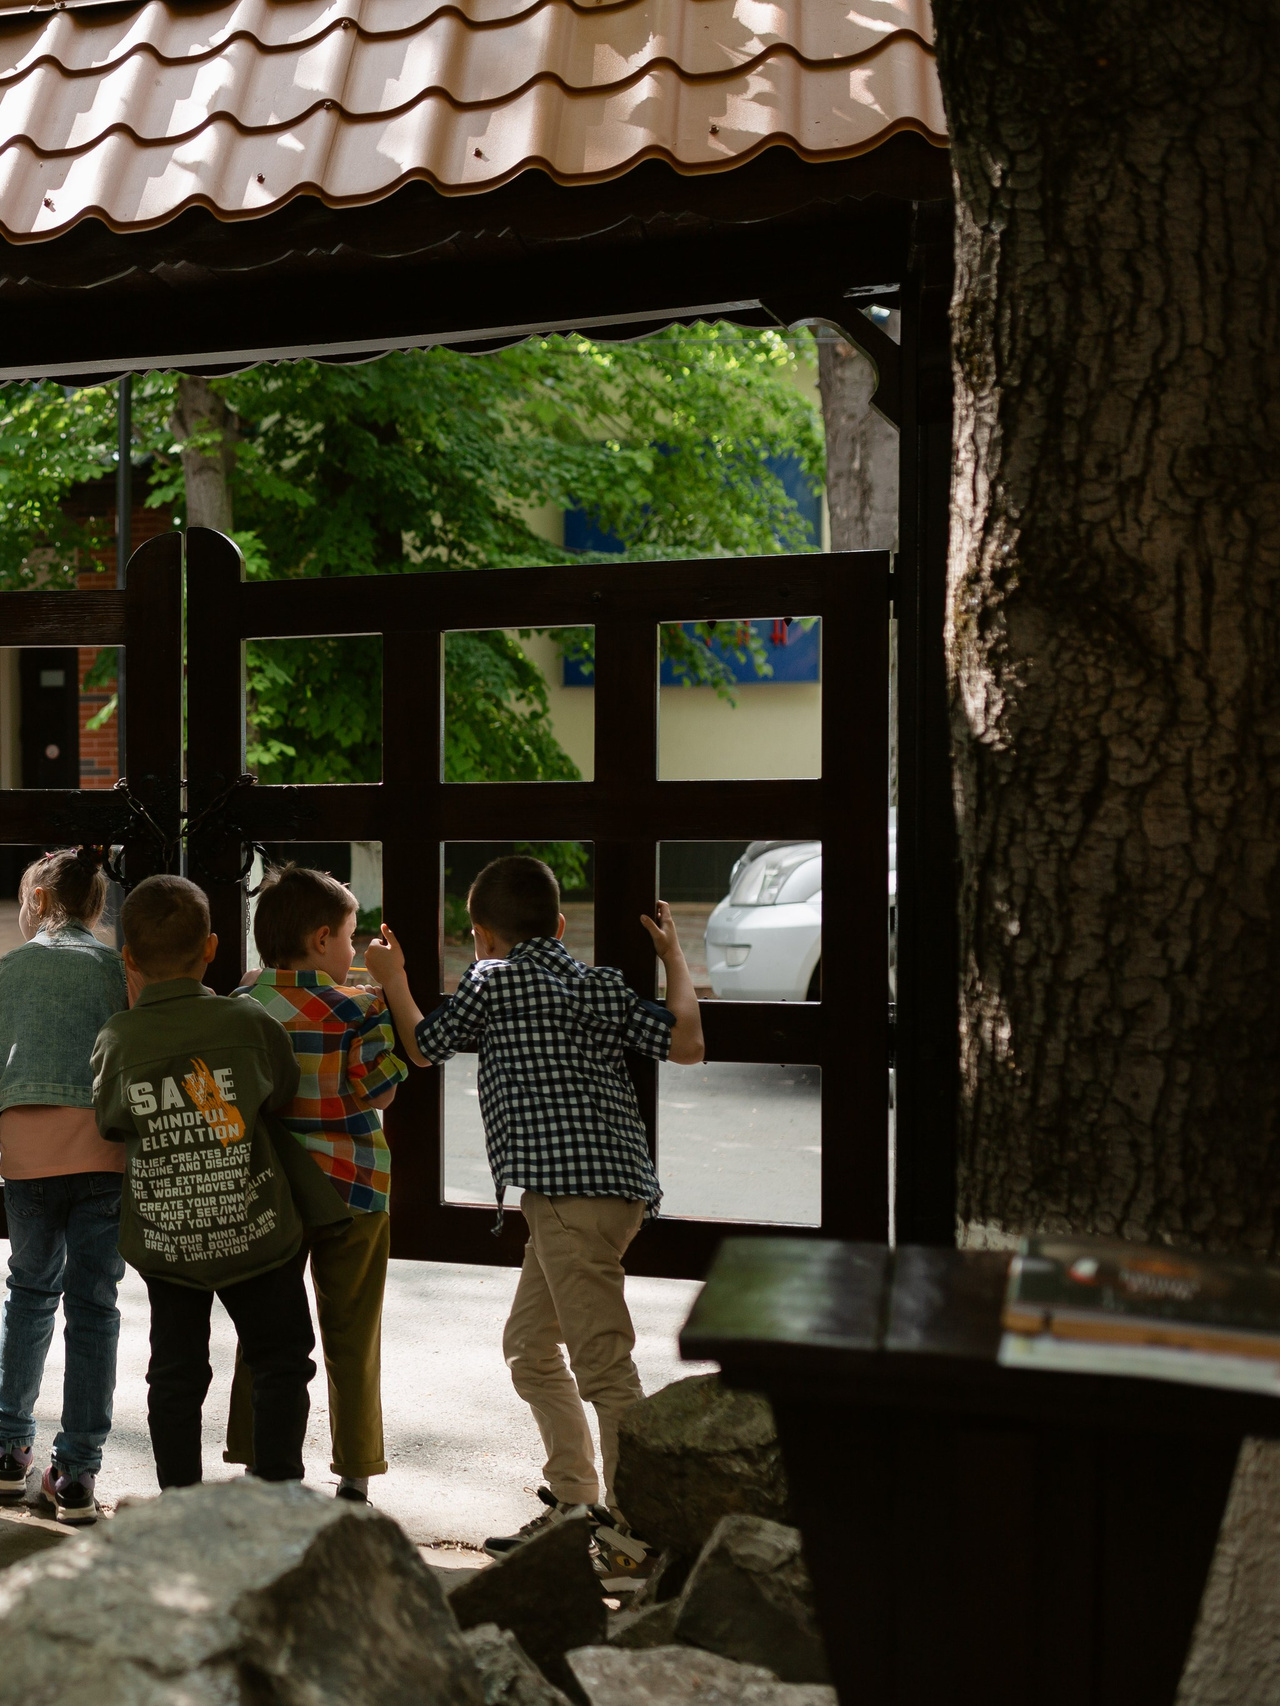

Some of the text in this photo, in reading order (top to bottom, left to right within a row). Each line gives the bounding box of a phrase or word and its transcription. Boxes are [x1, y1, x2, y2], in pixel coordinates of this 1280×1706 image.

[148, 1108, 228, 1133] MINDFUL
[142, 1123, 240, 1152] ELEVATION
[170, 1148, 222, 1164] CREATES
[179, 1161, 201, 1173] AND
[205, 1152, 251, 1170] DISCOVE
[148, 1178, 171, 1189] THE
[153, 1185, 192, 1199] WORLD
[197, 1180, 235, 1194] MOVES
[139, 1200, 184, 1212] CREATE
[186, 1196, 217, 1209] YOUR
[218, 1192, 245, 1205] OWN
[160, 1209, 192, 1221] MUST
[187, 1217, 212, 1229] YOU
[143, 1228, 170, 1243] TRAIN
[171, 1233, 203, 1246] YOUR
[207, 1228, 236, 1241] MIND
[241, 1222, 256, 1234] TO
[145, 1219, 276, 1254] BREAK THE BOUNDARIES
[165, 1242, 249, 1263] OF LIMITATION
